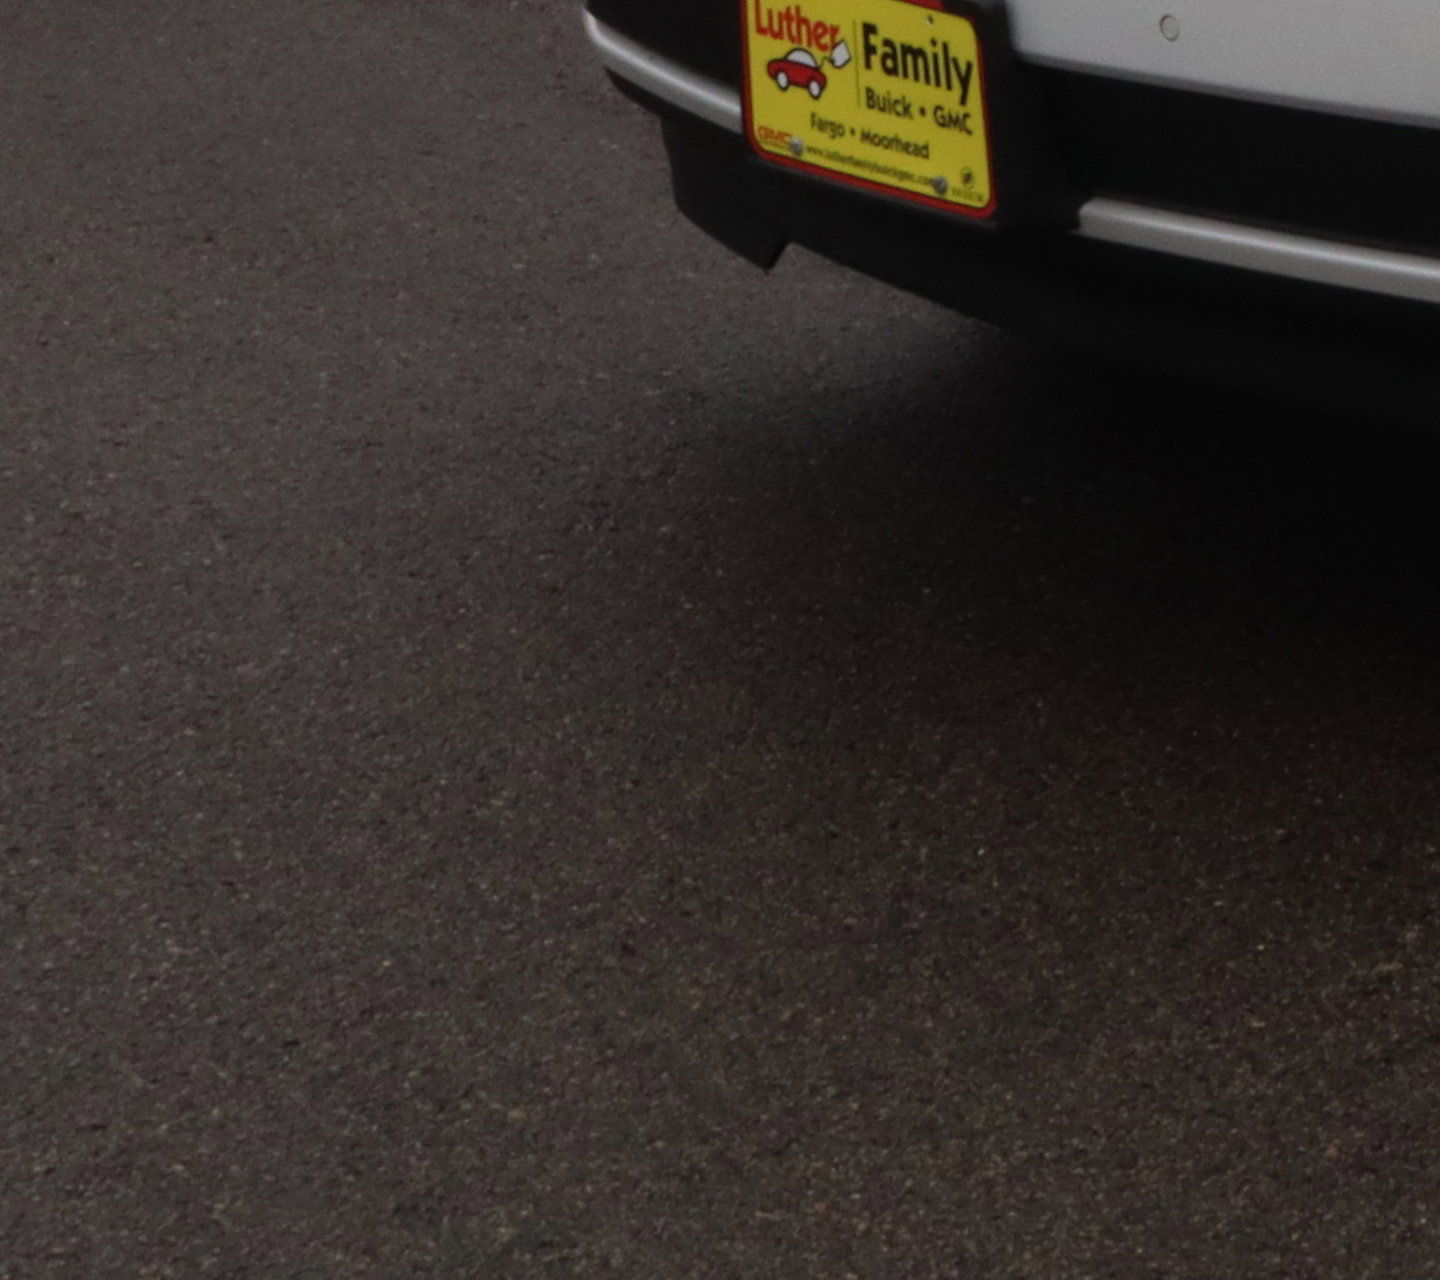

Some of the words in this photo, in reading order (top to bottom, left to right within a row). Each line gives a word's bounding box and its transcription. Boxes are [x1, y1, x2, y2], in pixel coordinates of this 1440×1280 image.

[862, 22, 974, 107] Family
[865, 86, 914, 121] Buick
[933, 104, 974, 136] GMC
[810, 112, 846, 140] Fargo
[860, 127, 931, 161] Moorhead
